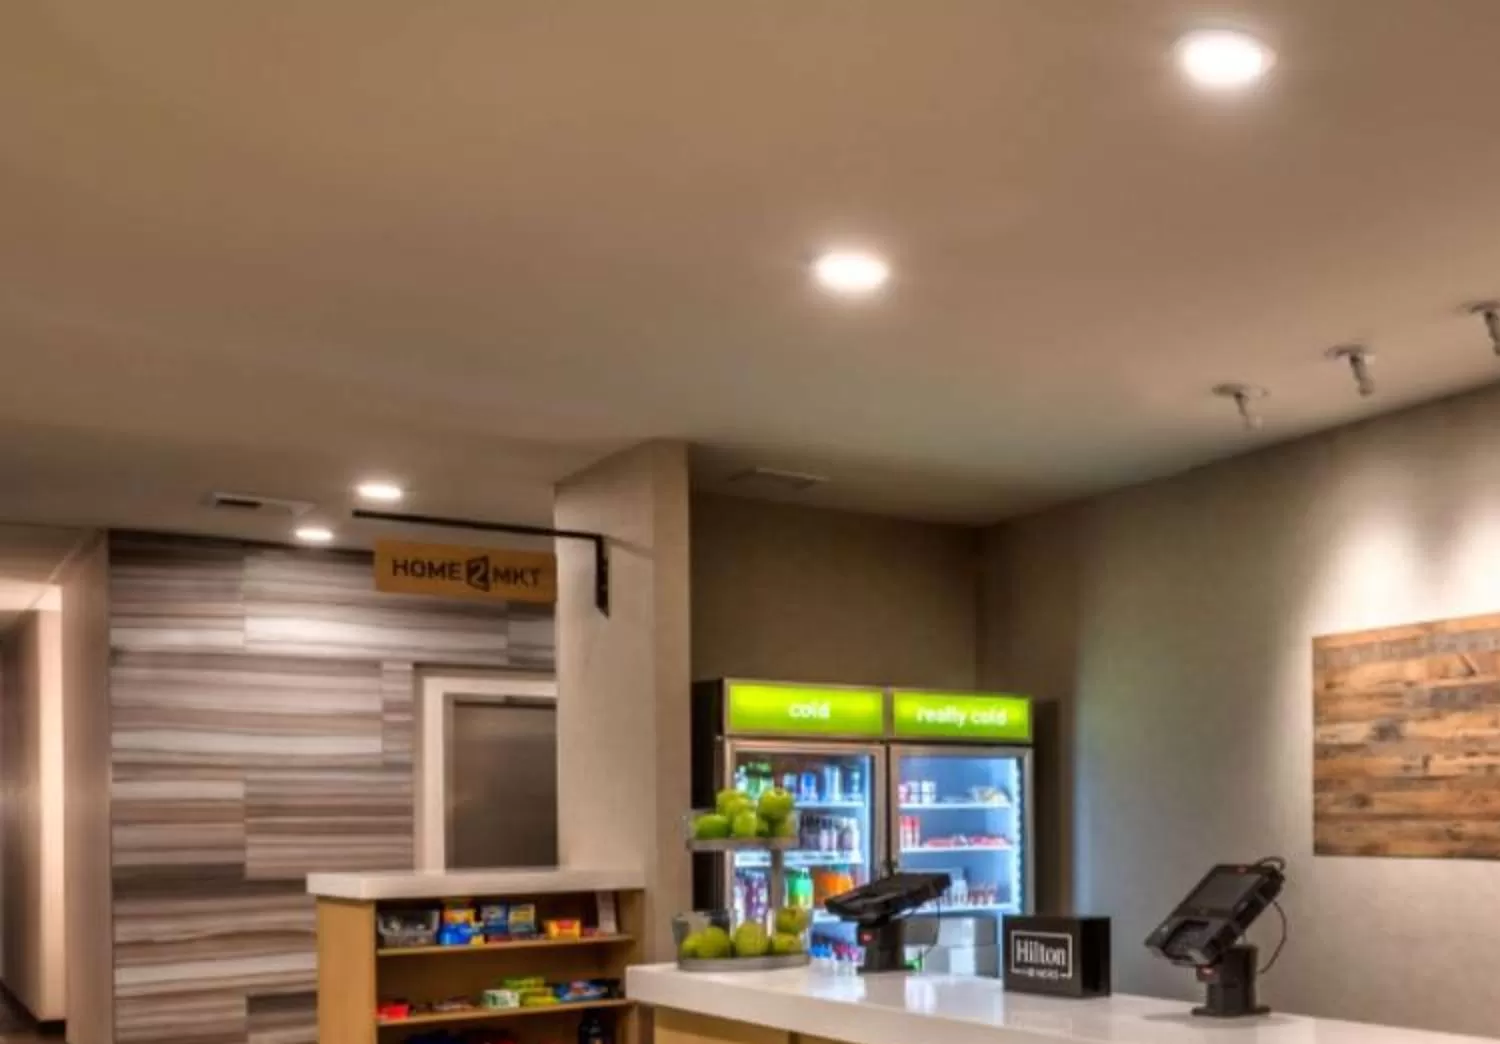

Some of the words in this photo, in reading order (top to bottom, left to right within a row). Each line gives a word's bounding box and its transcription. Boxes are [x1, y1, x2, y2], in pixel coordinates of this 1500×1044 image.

[788, 702, 831, 720] cold
[916, 705, 967, 728] really
[971, 707, 1008, 726] cold
[1015, 939, 1066, 966] Hilton
